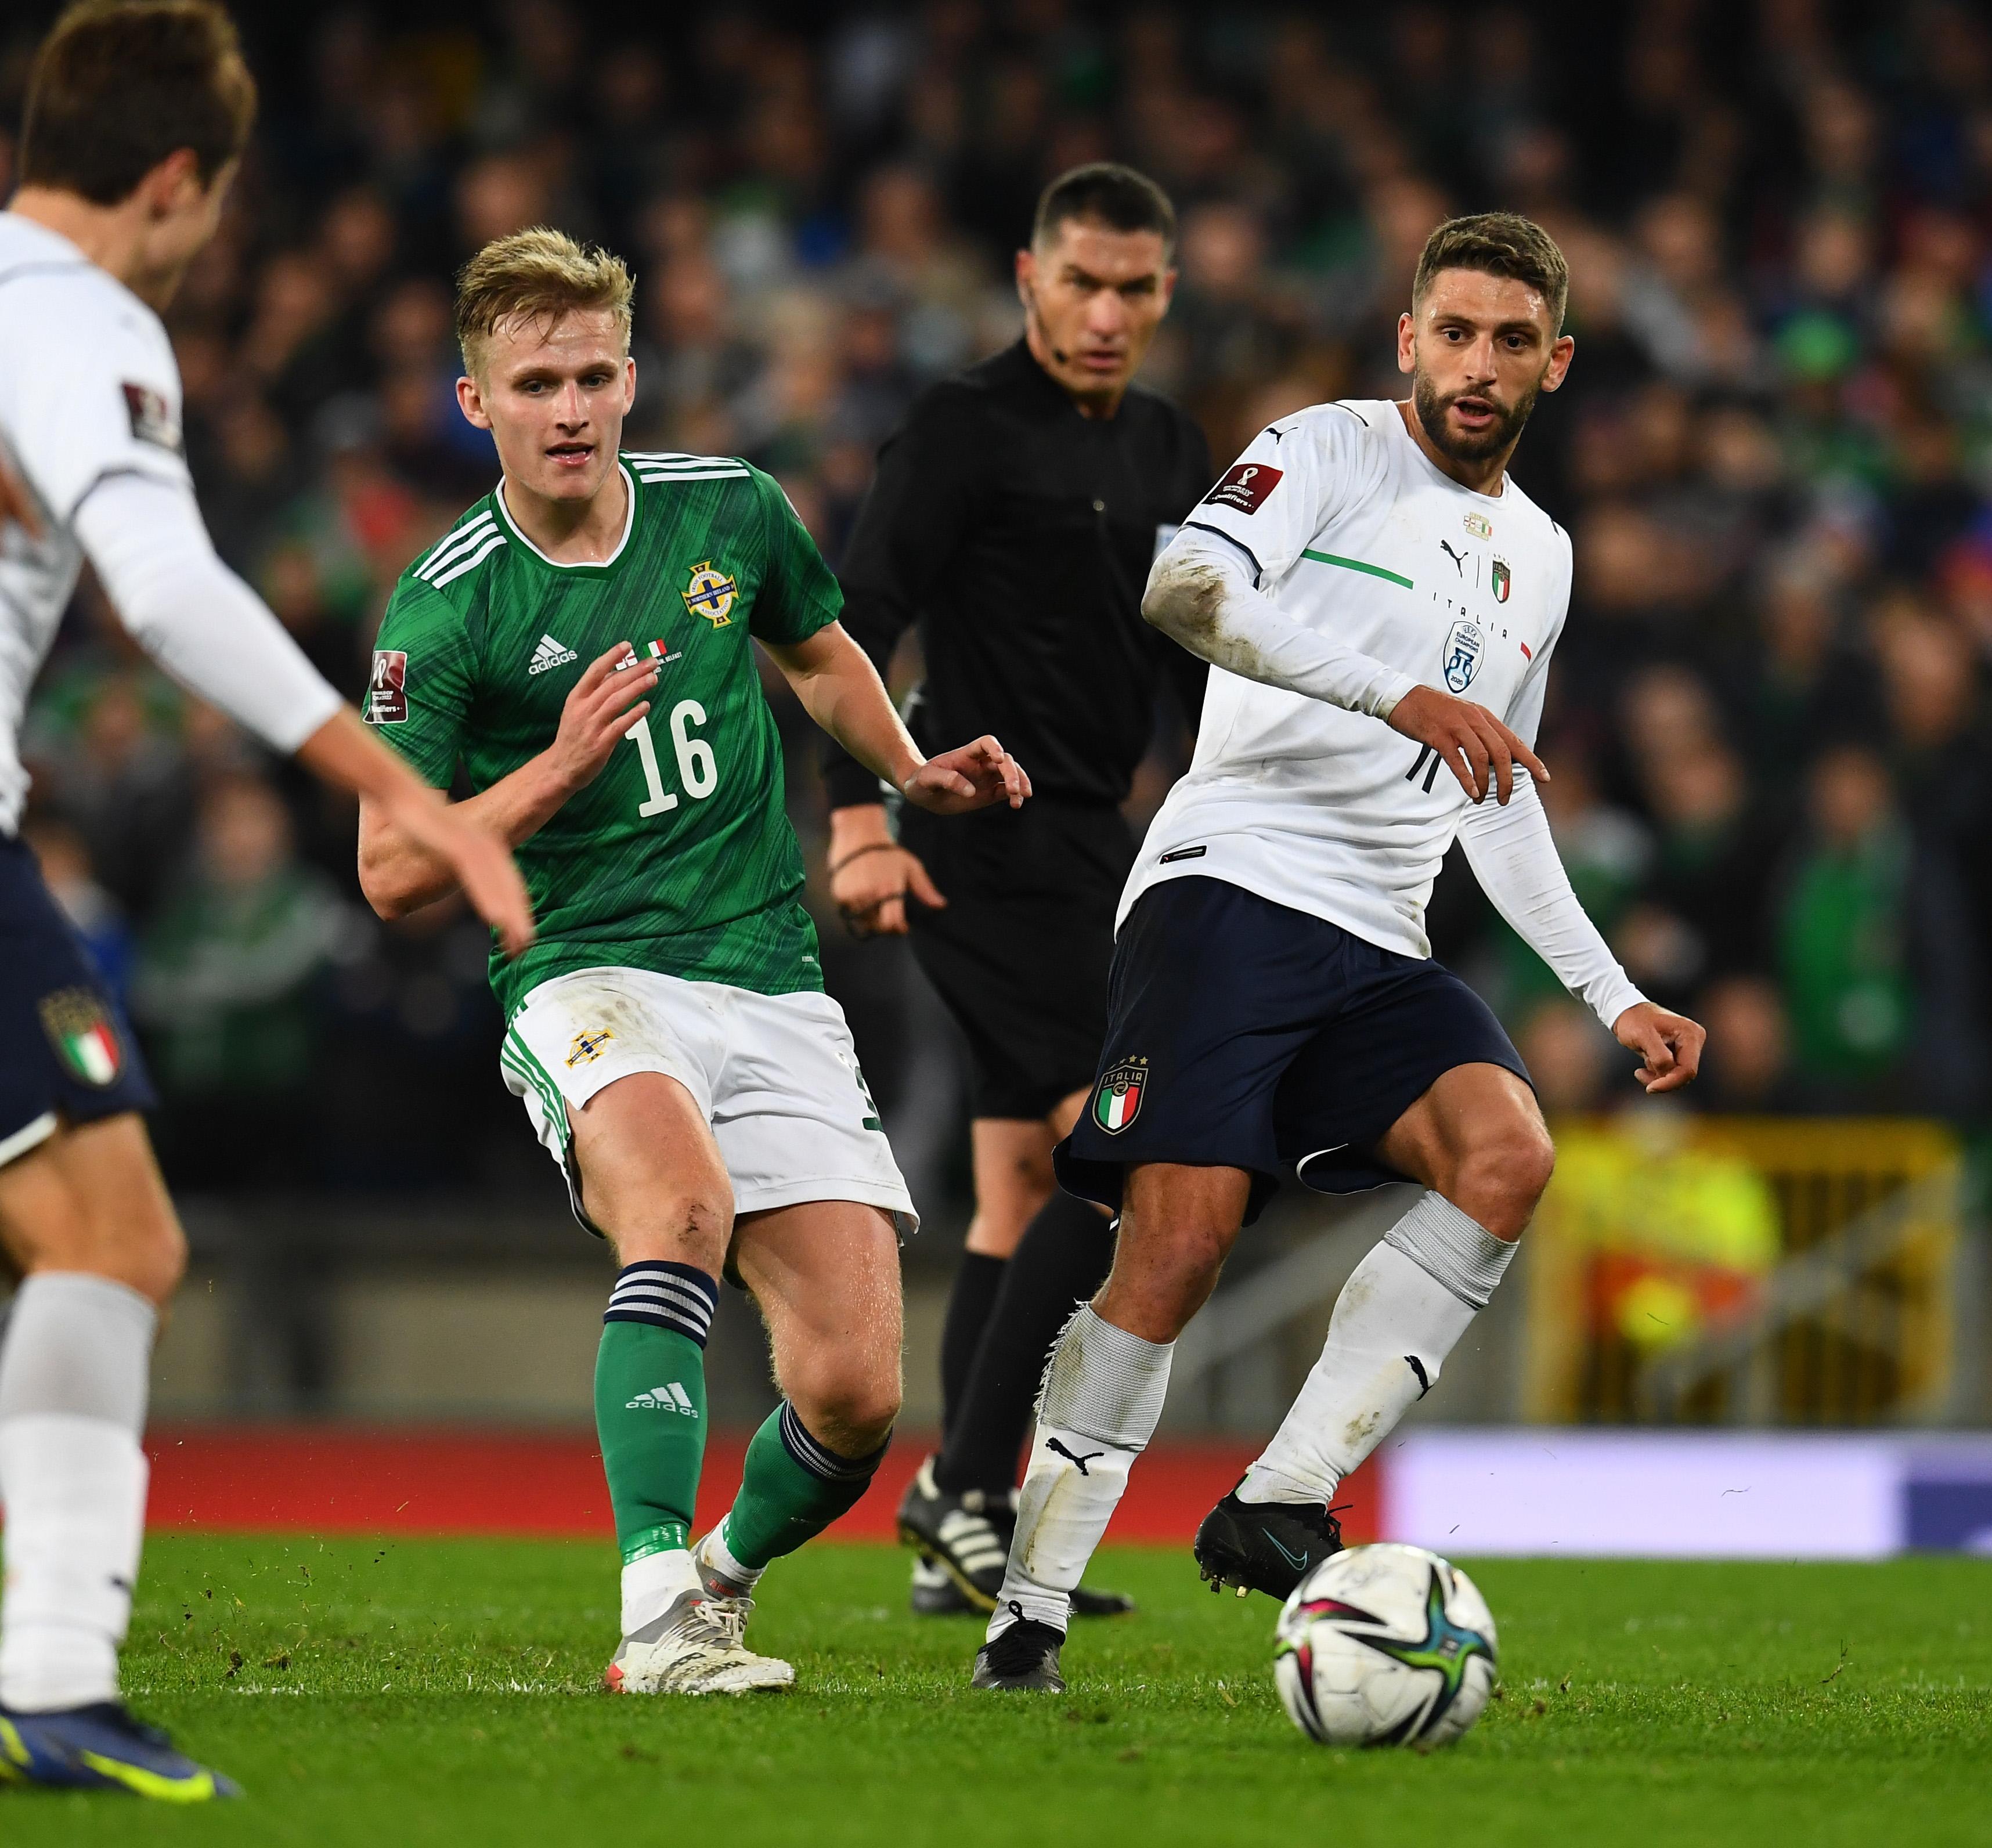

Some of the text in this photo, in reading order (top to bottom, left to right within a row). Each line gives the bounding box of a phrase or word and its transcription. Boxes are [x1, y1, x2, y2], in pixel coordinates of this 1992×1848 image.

[698, 572, 724, 582] FOOTBALL
[691, 585, 731, 604] NORTHERN IRELAND
[701, 599, 730, 616] ASSOCIATION
[1433, 592, 1507, 639] ITALIA
[1455, 637, 1479, 654] CHAMPIONS
[1456, 630, 1480, 648] EUROPEAN
[528, 650, 578, 675] adidas
[665, 651, 683, 662] BELFAST
[1450, 675, 1463, 686] 2020
[625, 699, 718, 818] 16
[1105, 1072, 1142, 1084] ITALIA
[625, 1398, 698, 1419] adidas
